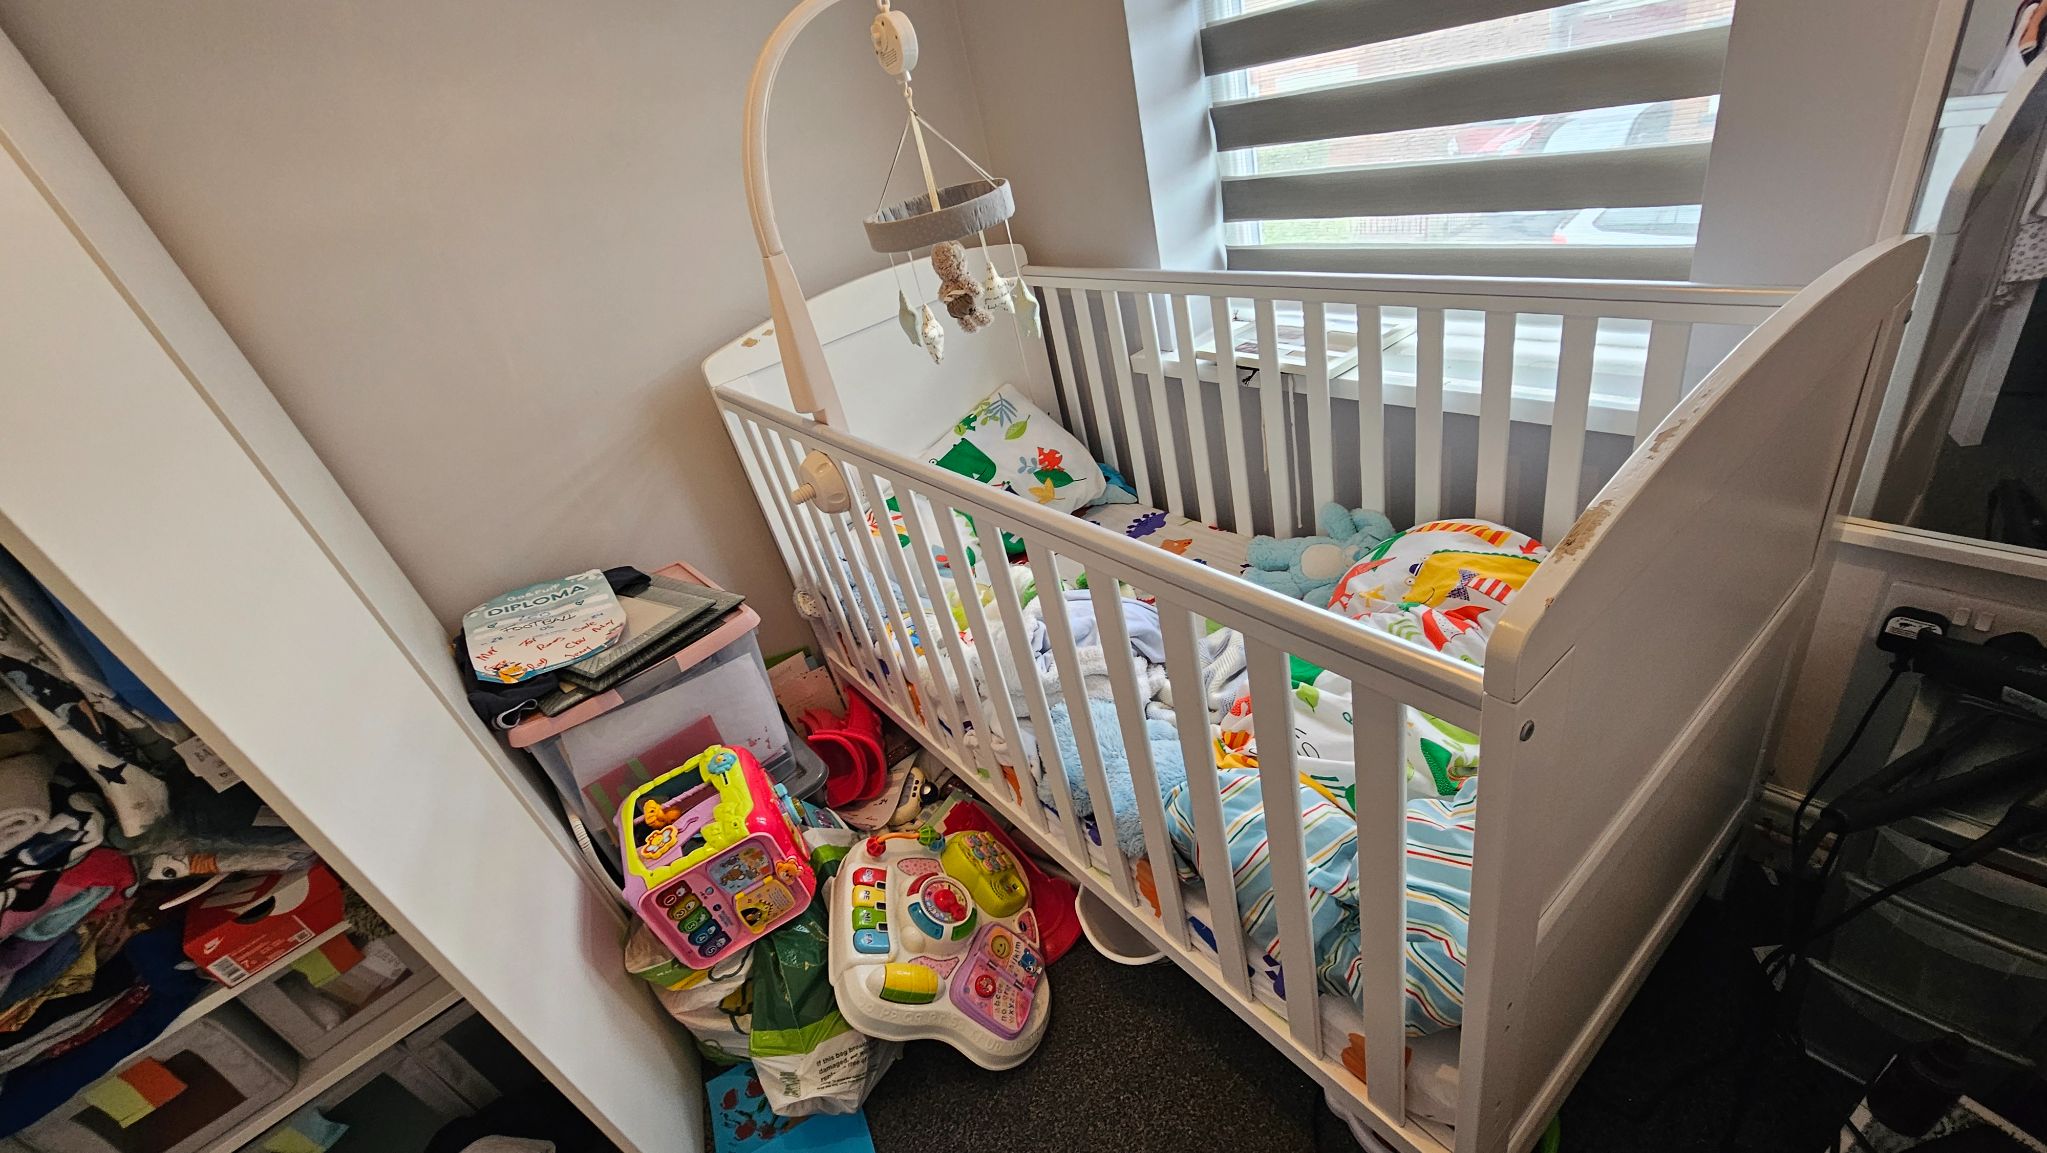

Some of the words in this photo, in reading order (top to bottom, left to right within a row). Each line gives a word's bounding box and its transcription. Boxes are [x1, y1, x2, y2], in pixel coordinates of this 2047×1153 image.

[487, 585, 586, 617] DIPLOMA
[864, 889, 871, 901] RE
[864, 912, 872, 922] MI
[865, 933, 873, 944] FA
